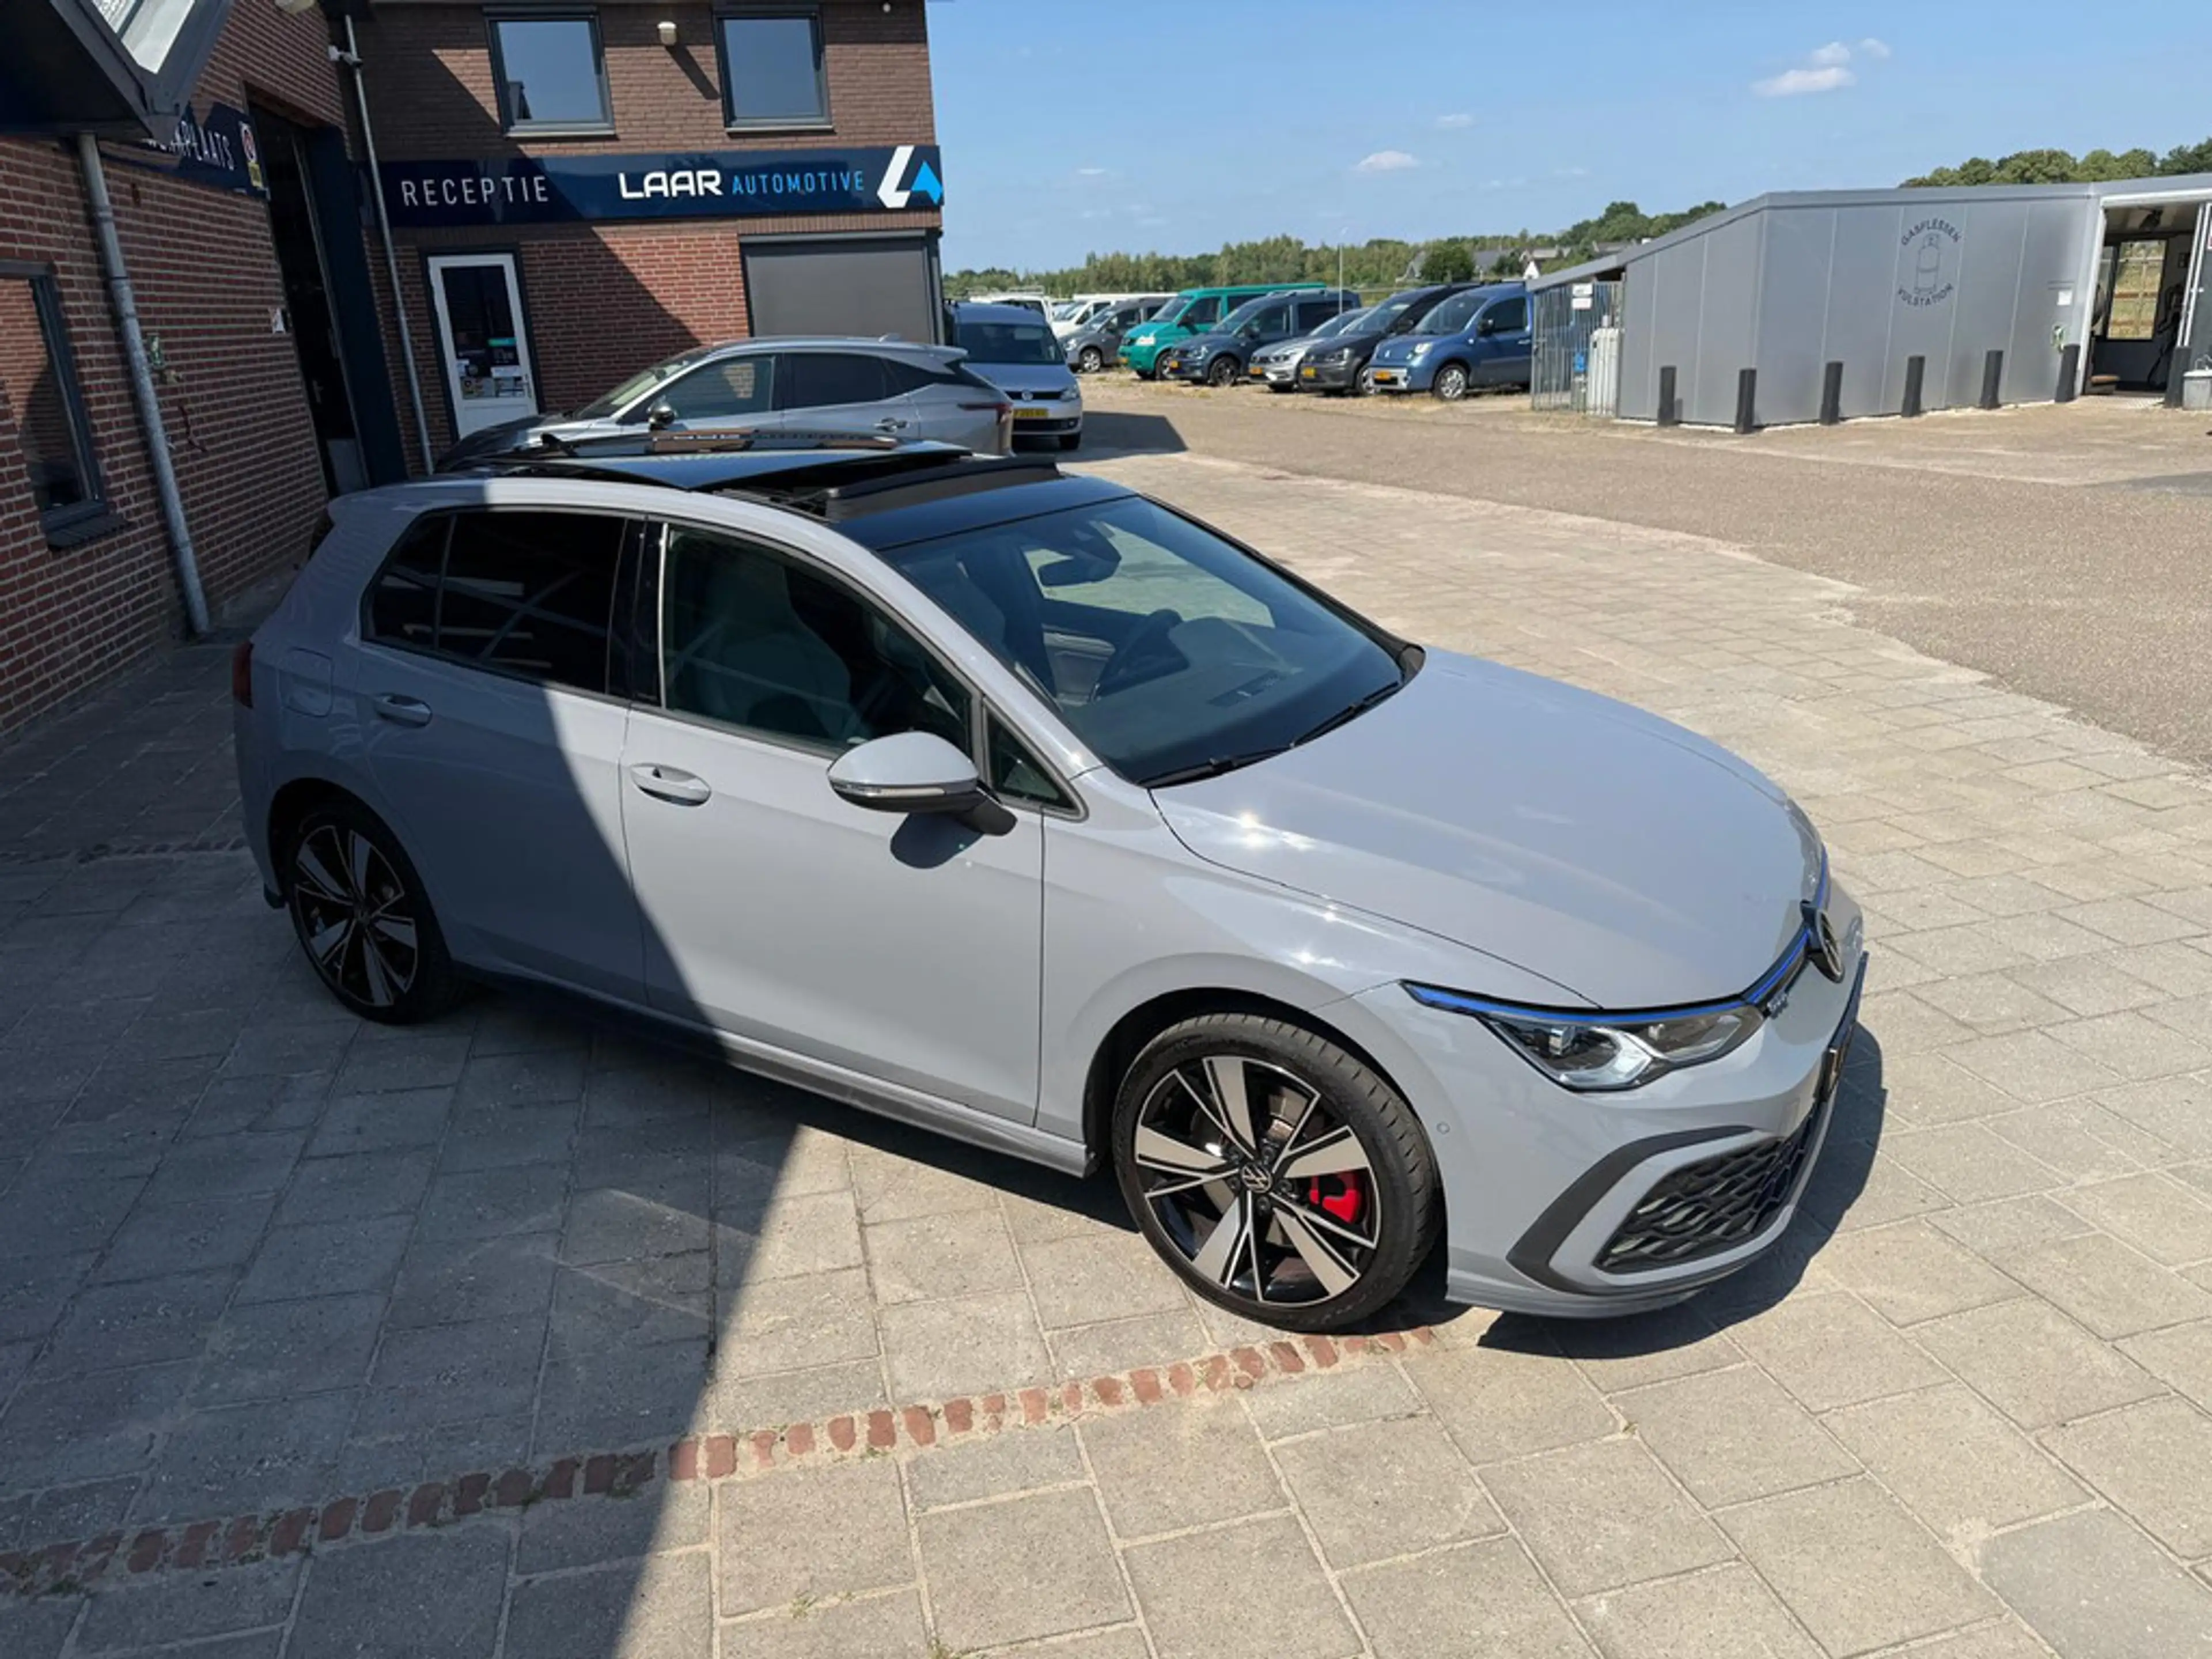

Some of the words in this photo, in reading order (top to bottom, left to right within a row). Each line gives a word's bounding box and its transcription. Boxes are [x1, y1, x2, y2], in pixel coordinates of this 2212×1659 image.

[402, 175, 548, 206] RECEPTIE
[619, 169, 724, 199] LAAR
[732, 171, 864, 195] AUTOMOTIVE
